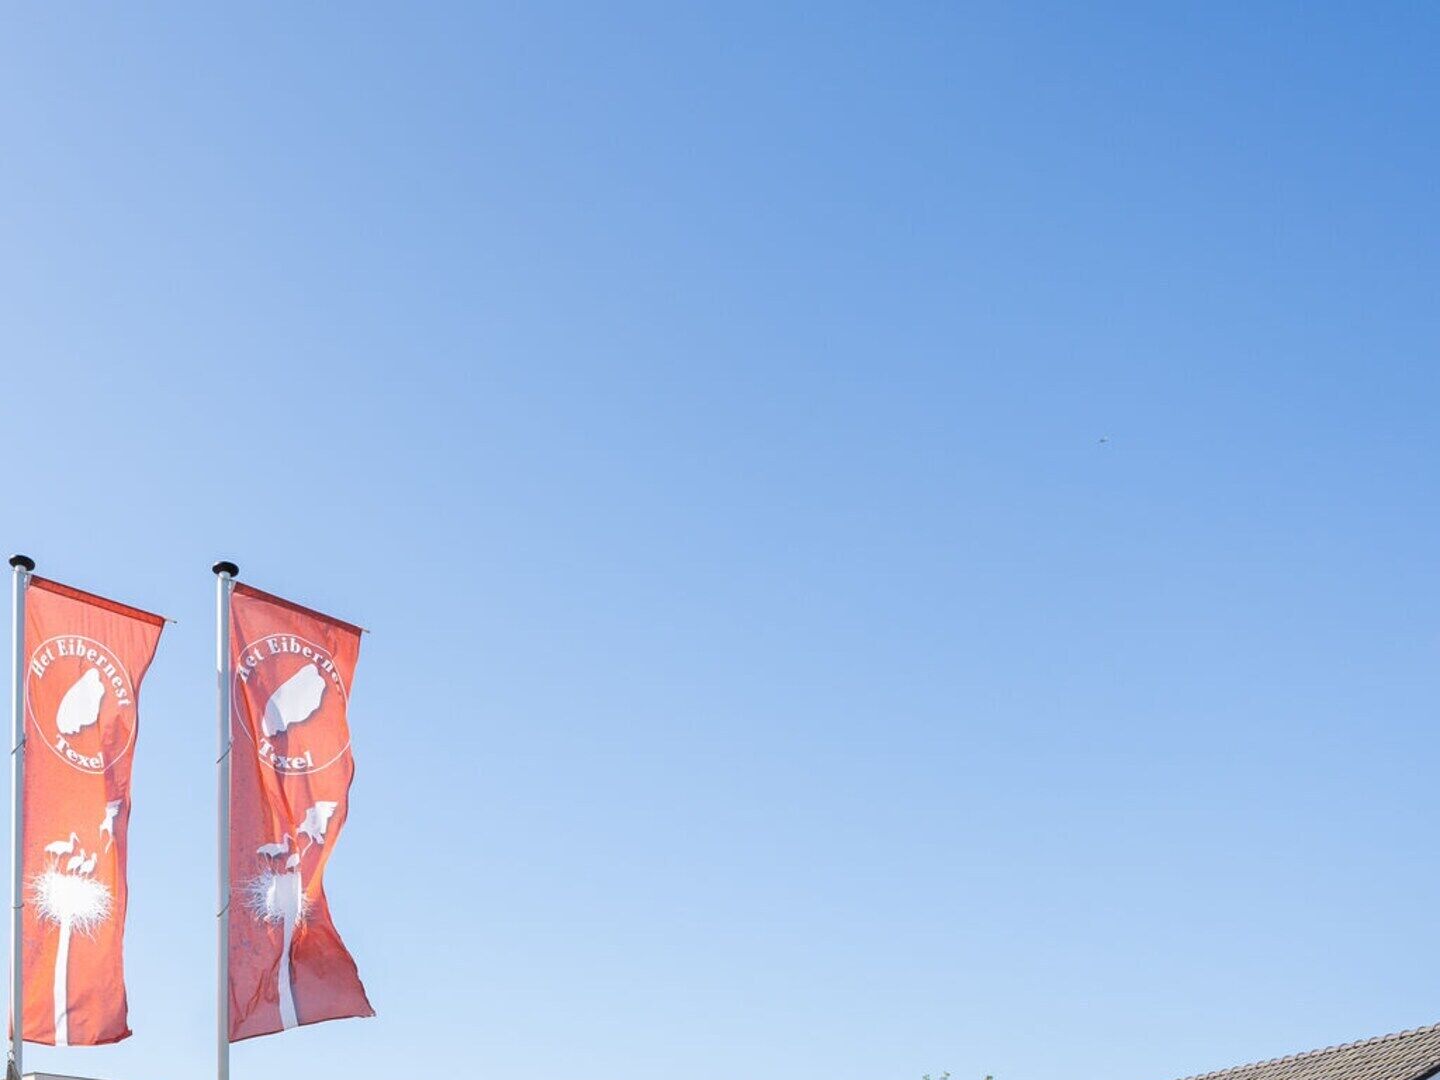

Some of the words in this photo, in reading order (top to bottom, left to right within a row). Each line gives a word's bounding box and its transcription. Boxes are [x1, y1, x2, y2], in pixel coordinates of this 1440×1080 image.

[31, 647, 56, 679] Het
[56, 638, 132, 706] Eibernest
[55, 734, 105, 769] Texel
